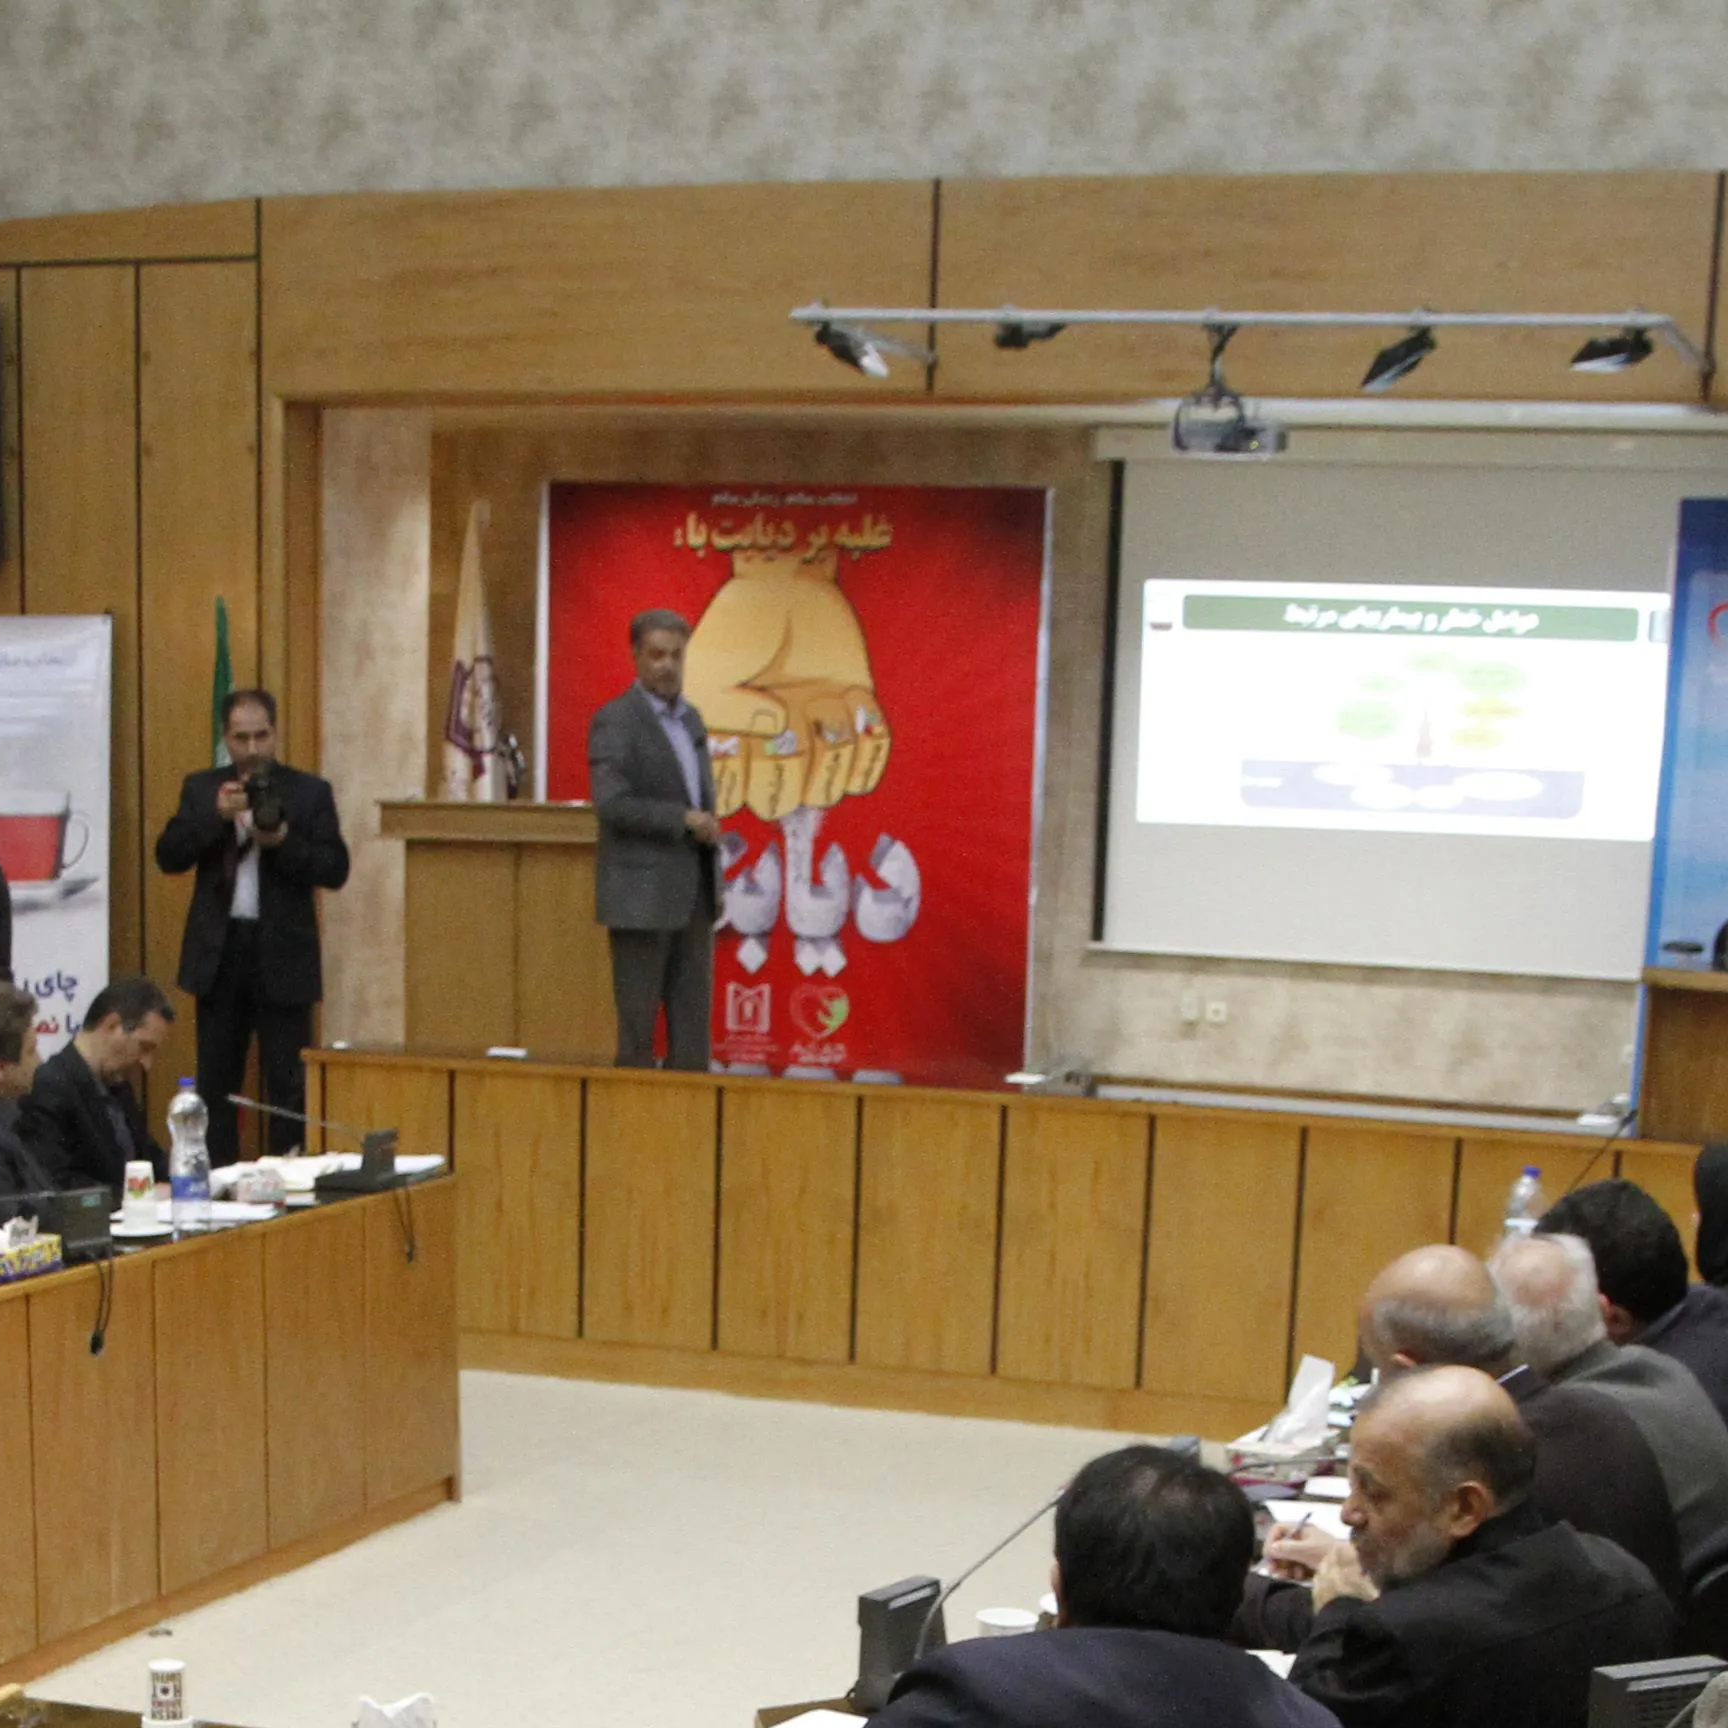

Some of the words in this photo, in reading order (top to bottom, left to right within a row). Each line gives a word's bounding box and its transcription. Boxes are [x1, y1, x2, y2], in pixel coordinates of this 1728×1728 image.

[711, 511, 797, 562] دیابت
[800, 525, 830, 564] بر
[833, 513, 894, 560] غلبه
[35, 969, 78, 1002] چای
